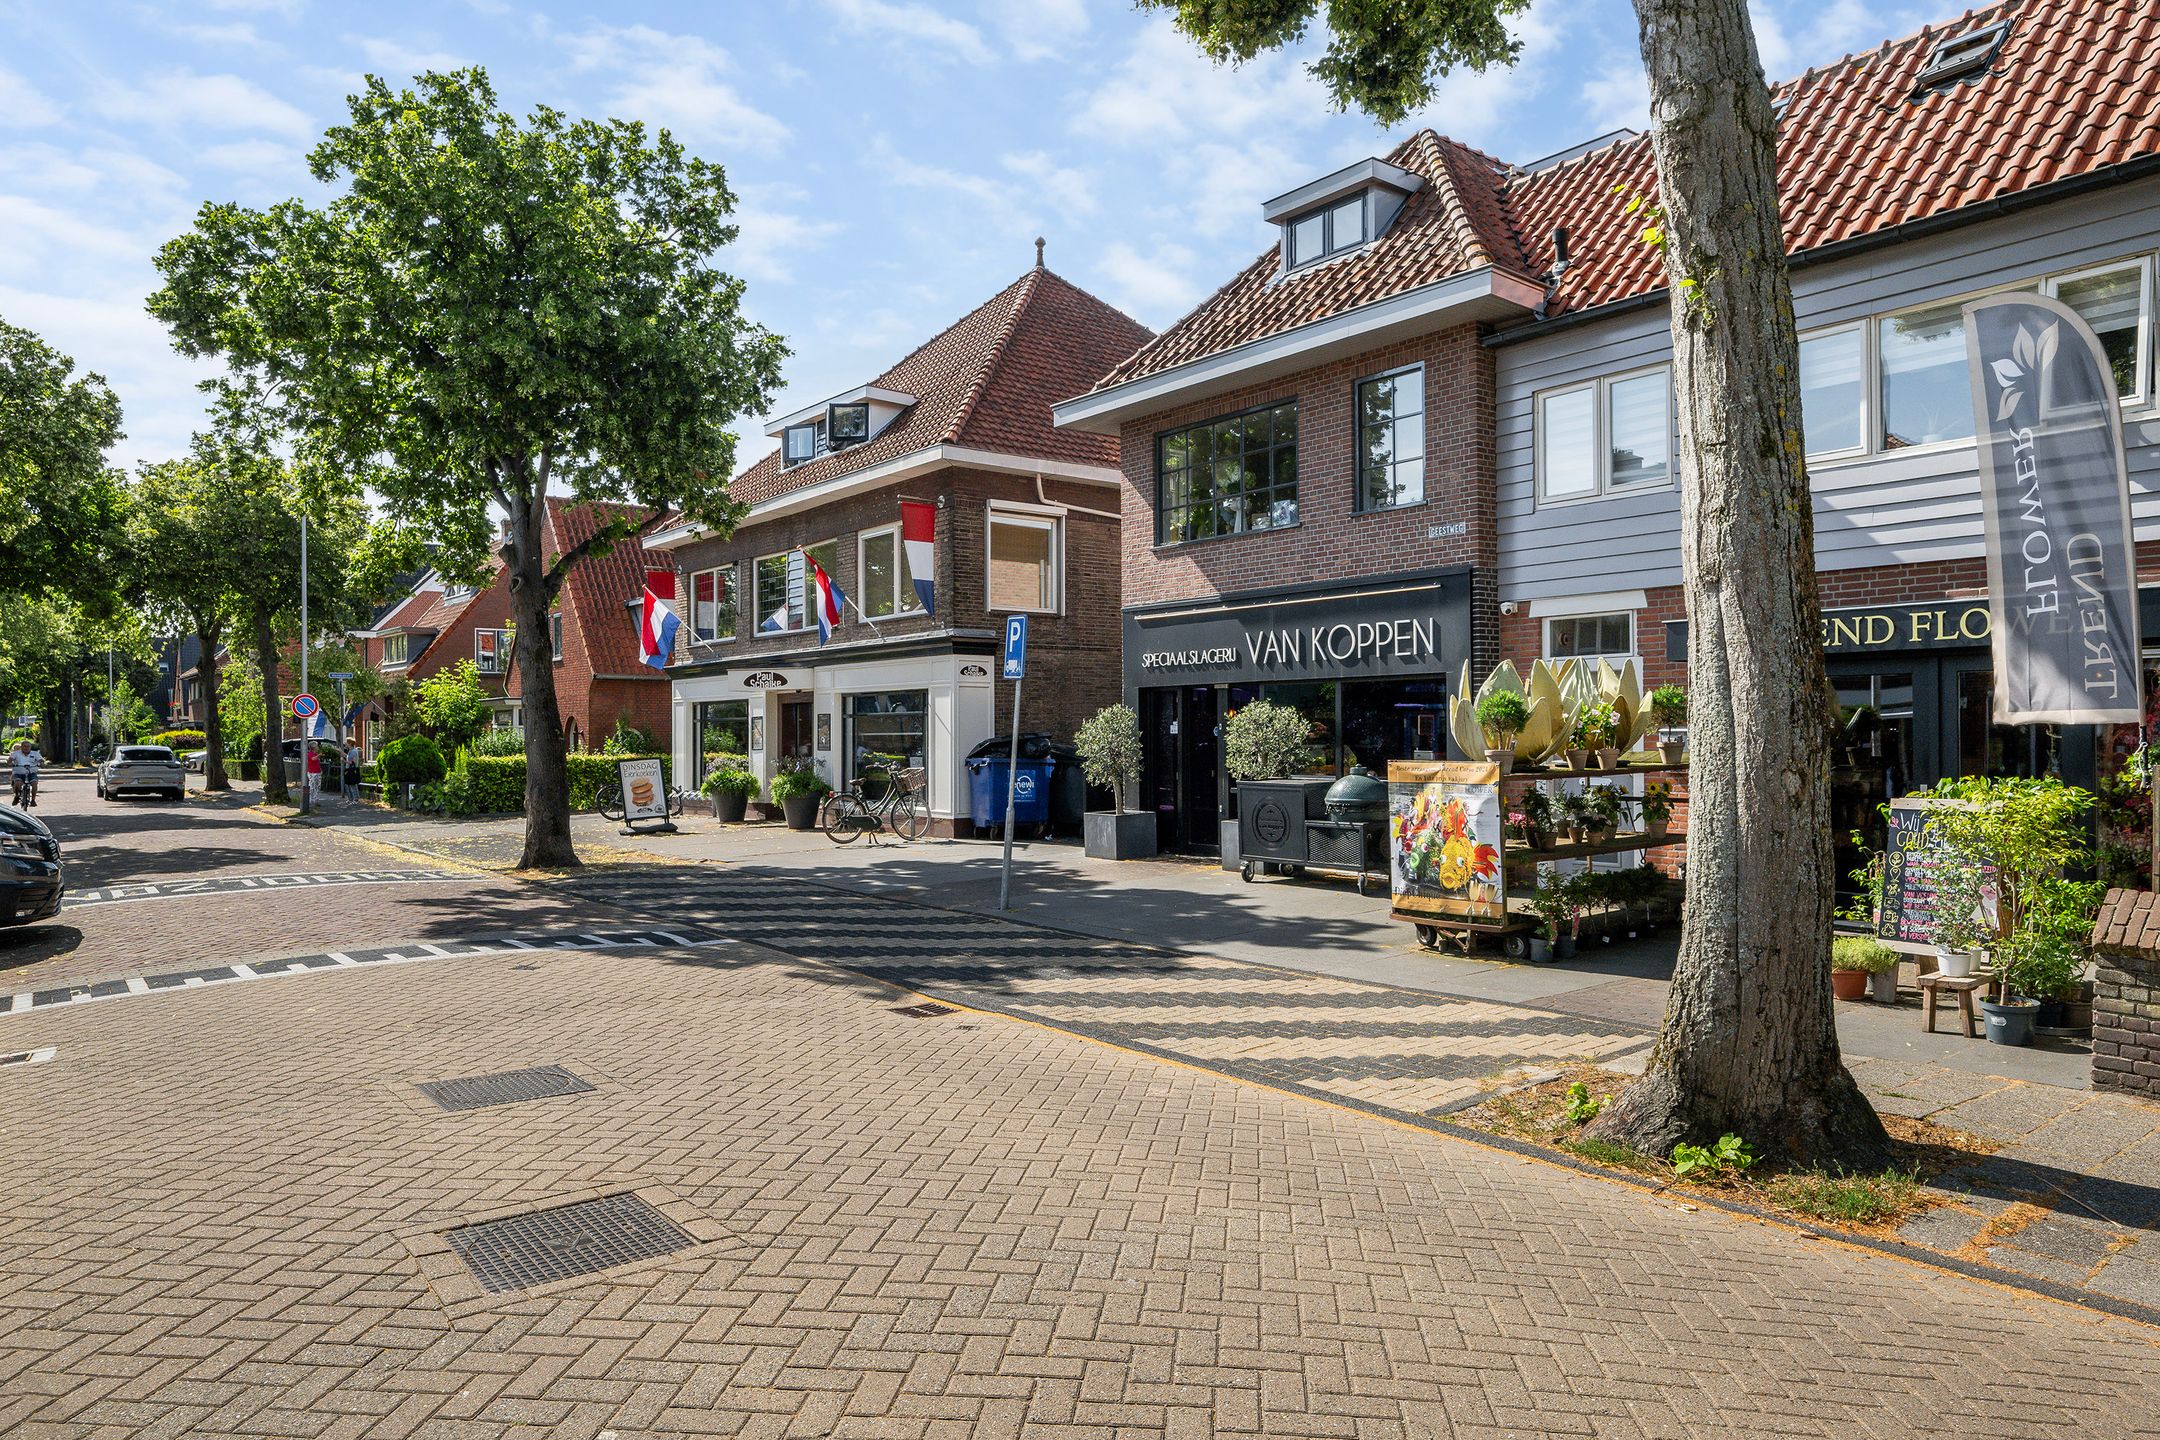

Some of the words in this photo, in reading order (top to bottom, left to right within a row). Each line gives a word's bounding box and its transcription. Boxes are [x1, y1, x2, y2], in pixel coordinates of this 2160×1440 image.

[1430, 523, 1465, 536] GEESTWEG
[1009, 621, 1021, 653] P
[1141, 646, 1237, 668] SPECIAALSLAGERIJ
[1245, 628, 1300, 665] VAN
[1311, 617, 1434, 661] KOPPEN
[750, 679, 782, 688] Schalke
[756, 671, 774, 681] Paul
[1900, 812, 1920, 832] Wij
